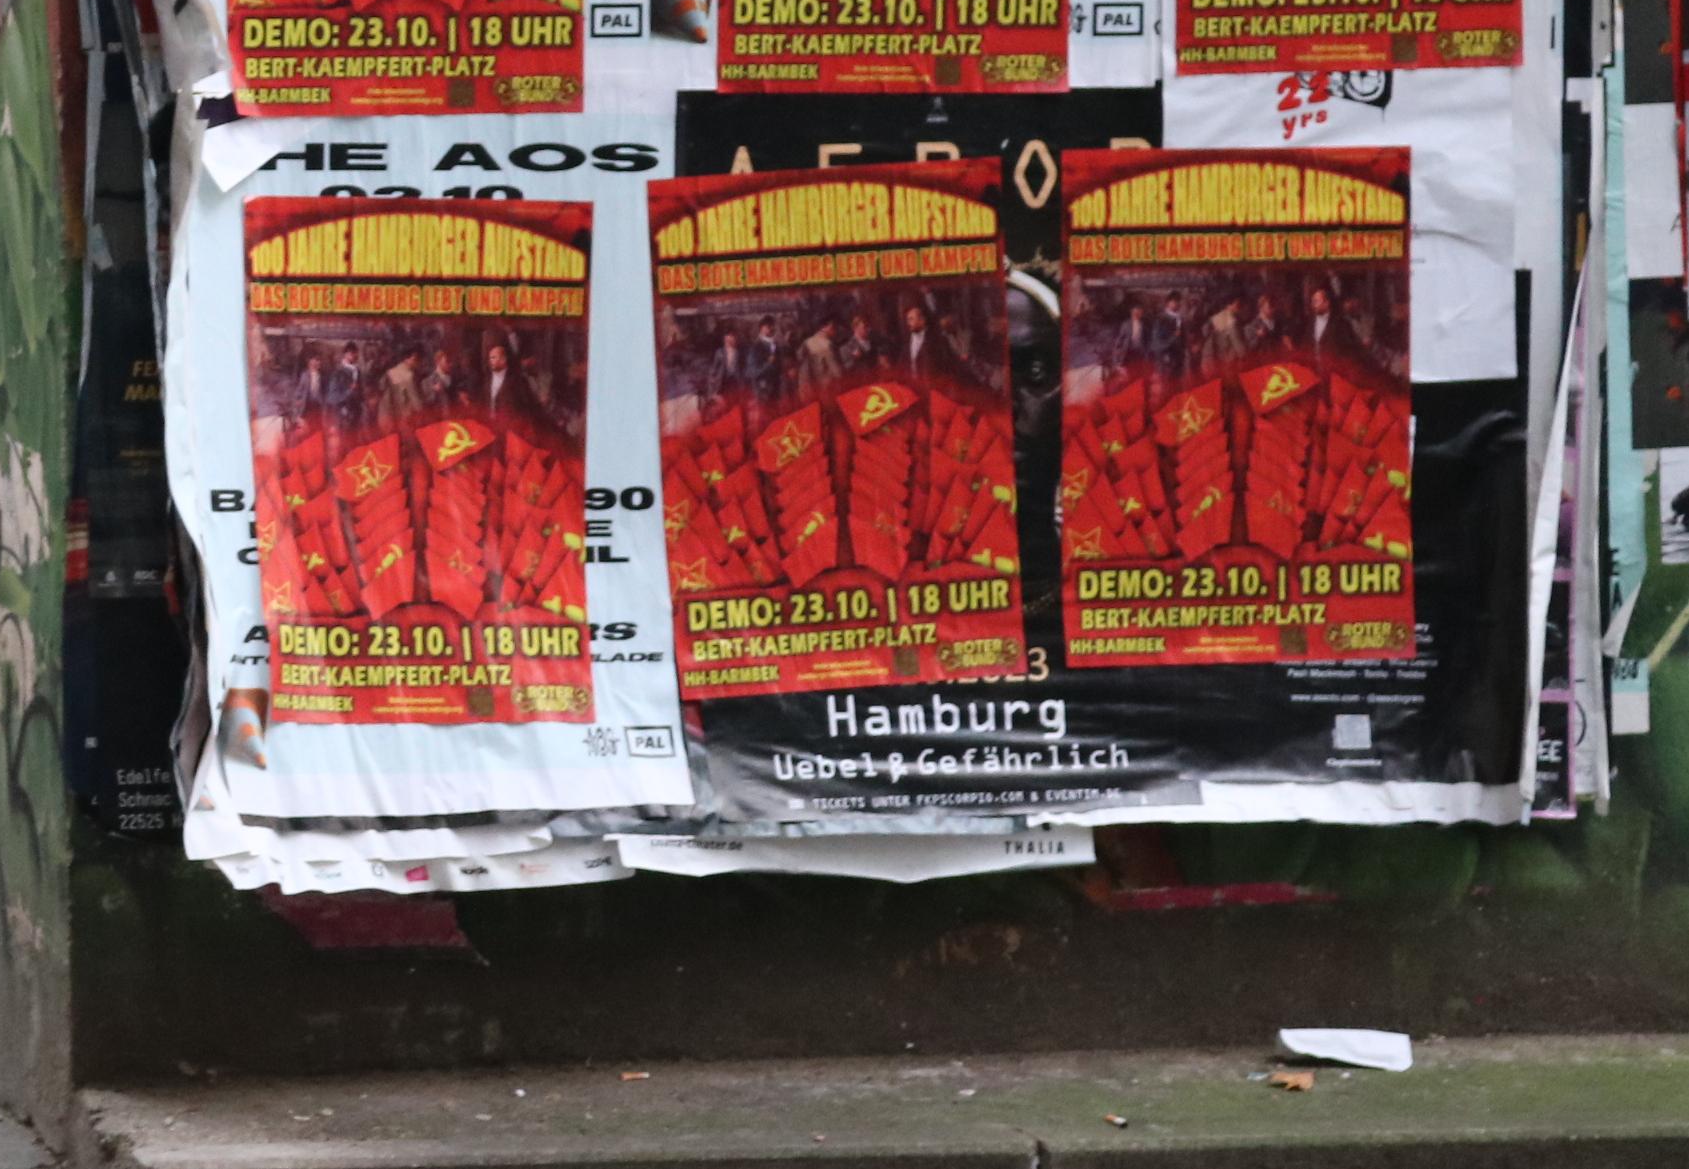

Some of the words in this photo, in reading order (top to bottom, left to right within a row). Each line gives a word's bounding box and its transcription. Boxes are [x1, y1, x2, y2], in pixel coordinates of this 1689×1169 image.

[244, 18, 339, 48] DEMO:
[348, 17, 437, 48] 23.10.
[470, 17, 502, 46] 18
[512, 16, 573, 46] UHR
[602, 15, 633, 28] PAL
[1103, 13, 1133, 25] PAL
[1194, 12, 1437, 38] BERT-KAEMPFERT-PLATZ
[734, 33, 982, 55] BERT-KAEMPFERT-PLATZ
[1180, 46, 1276, 64] HH-BARMBEK
[245, 55, 495, 79] BERT-KAEMPFERT-PLATZ
[721, 63, 820, 80] HH-BARMBEK
[237, 87, 330, 105] HH-BARMBEK
[1282, 110, 1328, 140] yrs
[434, 142, 659, 172] AOS
[1070, 189, 1106, 228] 100
[1109, 169, 1170, 226] JAHRE
[1174, 163, 1300, 224] HAMBURGER
[1304, 169, 1404, 223] AUFSTAND
[657, 217, 693, 258] 100
[698, 194, 759, 254] JAHRE
[761, 182, 890, 250] HAMBURGER
[894, 185, 996, 242] AUFSTAND
[251, 236, 284, 277] 100
[289, 218, 349, 275] JAHRE
[352, 213, 480, 276] HAMBURGER
[485, 221, 586, 280] AUFSTAND
[1070, 237, 1105, 263] DAS
[1109, 236, 1152, 261] ROTE
[1156, 234, 1243, 260] HAMBURG
[1246, 233, 1285, 259] LEBT
[1289, 232, 1325, 258] UND
[658, 264, 695, 292] DAS
[698, 260, 744, 290] ROTE
[747, 255, 832, 287] HAMBURG
[837, 251, 878, 281] LEBT
[881, 248, 919, 278] UND
[251, 283, 284, 312] DAS
[288, 284, 332, 312] ROTE
[334, 284, 419, 312] HAMBURG
[423, 285, 464, 313] LEBT
[466, 286, 502, 314] UND
[1079, 570, 1172, 600] DEMO:
[1182, 568, 1266, 597] 23.10.
[1300, 567, 1331, 595] 18
[1339, 565, 1400, 593] UHR
[689, 598, 782, 631] DEMO:
[791, 592, 878, 624] 23.10.
[909, 585, 939, 615] 18
[949, 580, 1008, 611] UHR
[1081, 603, 1325, 630] BERT-KAEMPFERT-PLATZ
[280, 625, 359, 655] DEMO:
[368, 626, 452, 656] 23.10.
[483, 627, 513, 656] 18
[521, 625, 579, 656] UHR
[693, 624, 937, 662] BERT-KAEMPFERT-PLATZ
[1070, 637, 1165, 654] HH-BARMBEK
[282, 664, 512, 687] BERT-KAEMPFERT-PLATZ
[684, 666, 779, 687] HH-BARMBEK
[273, 694, 353, 712] HH-BARMBEK
[826, 694, 1066, 739] Hamburg
[635, 736, 665, 749] PAL
[773, 752, 878, 781] Uebel
[888, 752, 909, 783] &
[918, 743, 1130, 776] Gefährlich
[813, 796, 865, 810] TICKETS
[871, 794, 910, 808] UNTER
[119, 815, 163, 830] 22525
[1004, 840, 1066, 856] THALIA
